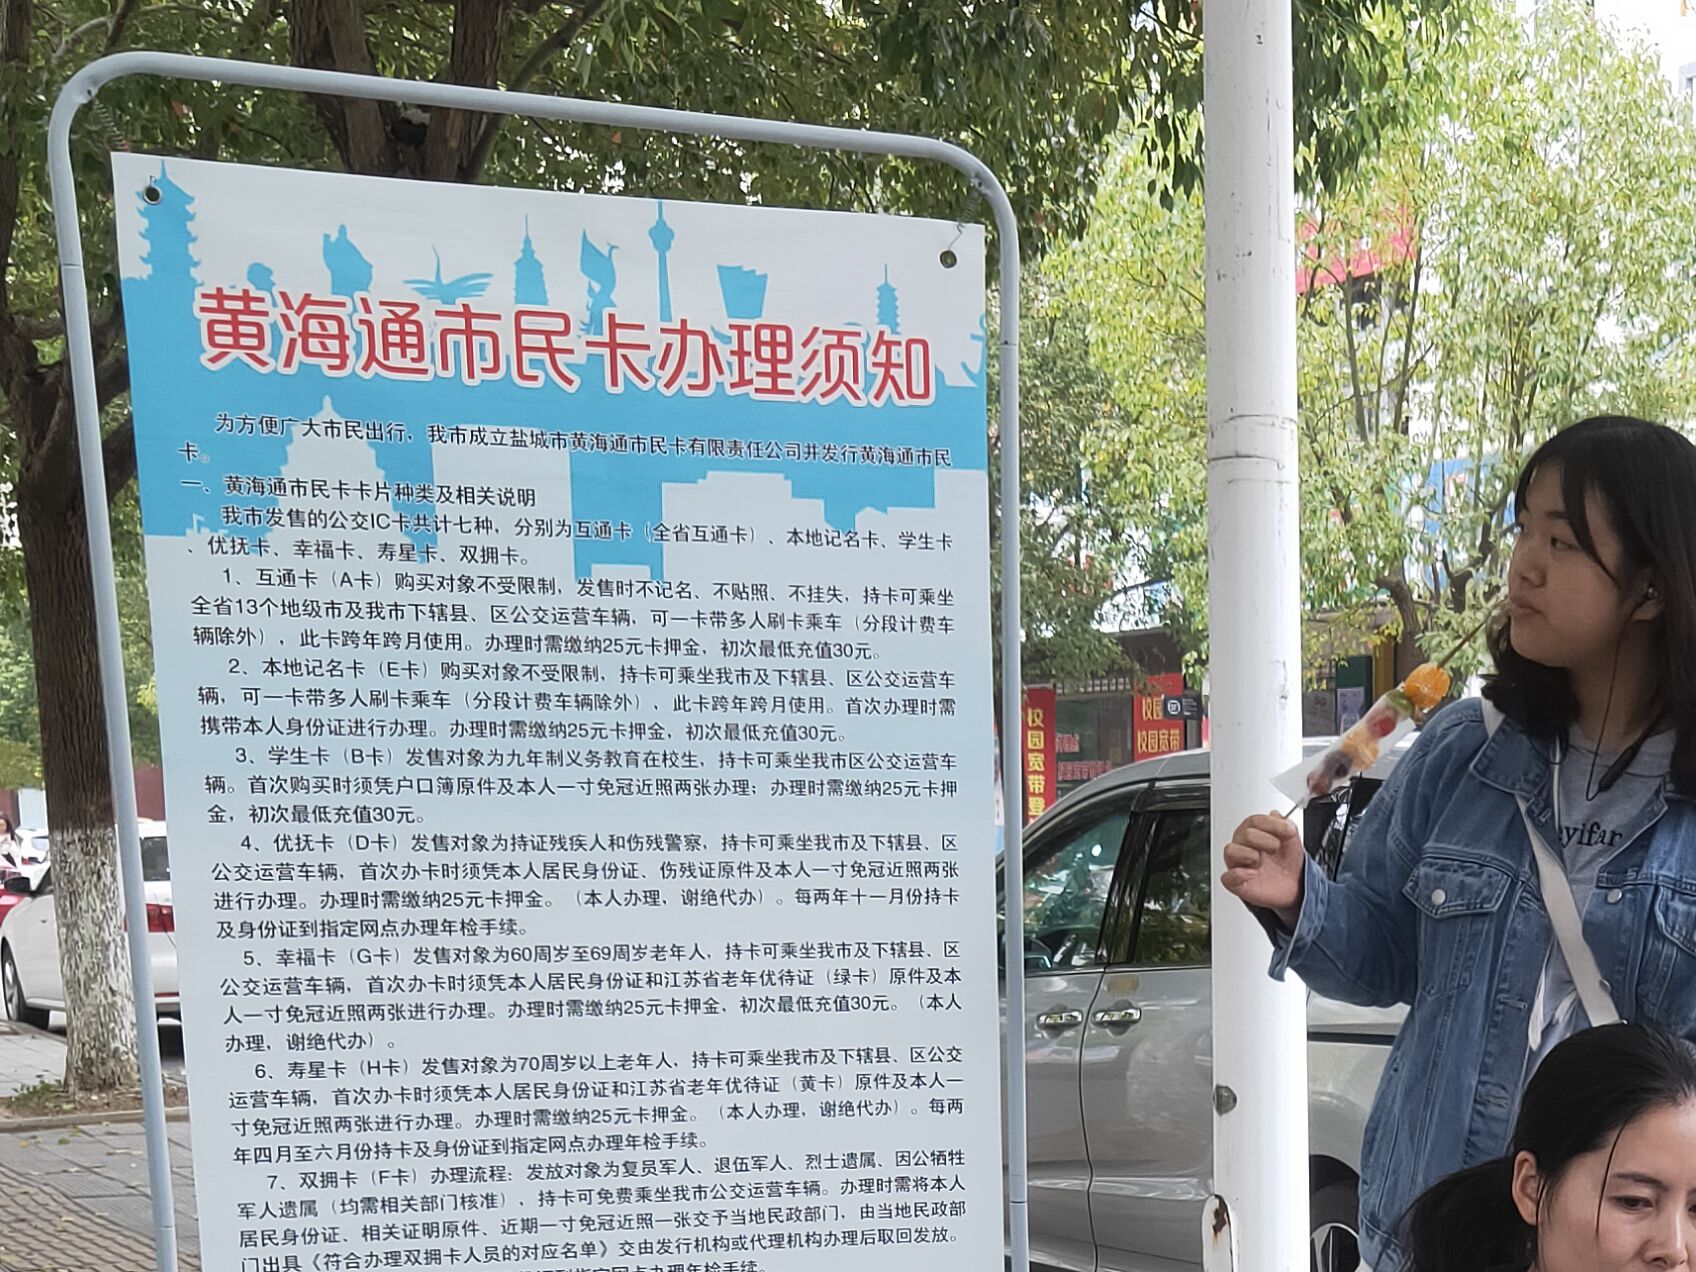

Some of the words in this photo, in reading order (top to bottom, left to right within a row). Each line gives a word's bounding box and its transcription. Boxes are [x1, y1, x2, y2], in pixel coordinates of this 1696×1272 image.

[197, 286, 933, 402] 黄海通市民卡办理须知
[1026, 707, 1046, 823] 校园宽带登
[1137, 728, 1181, 754] 校园宽带
